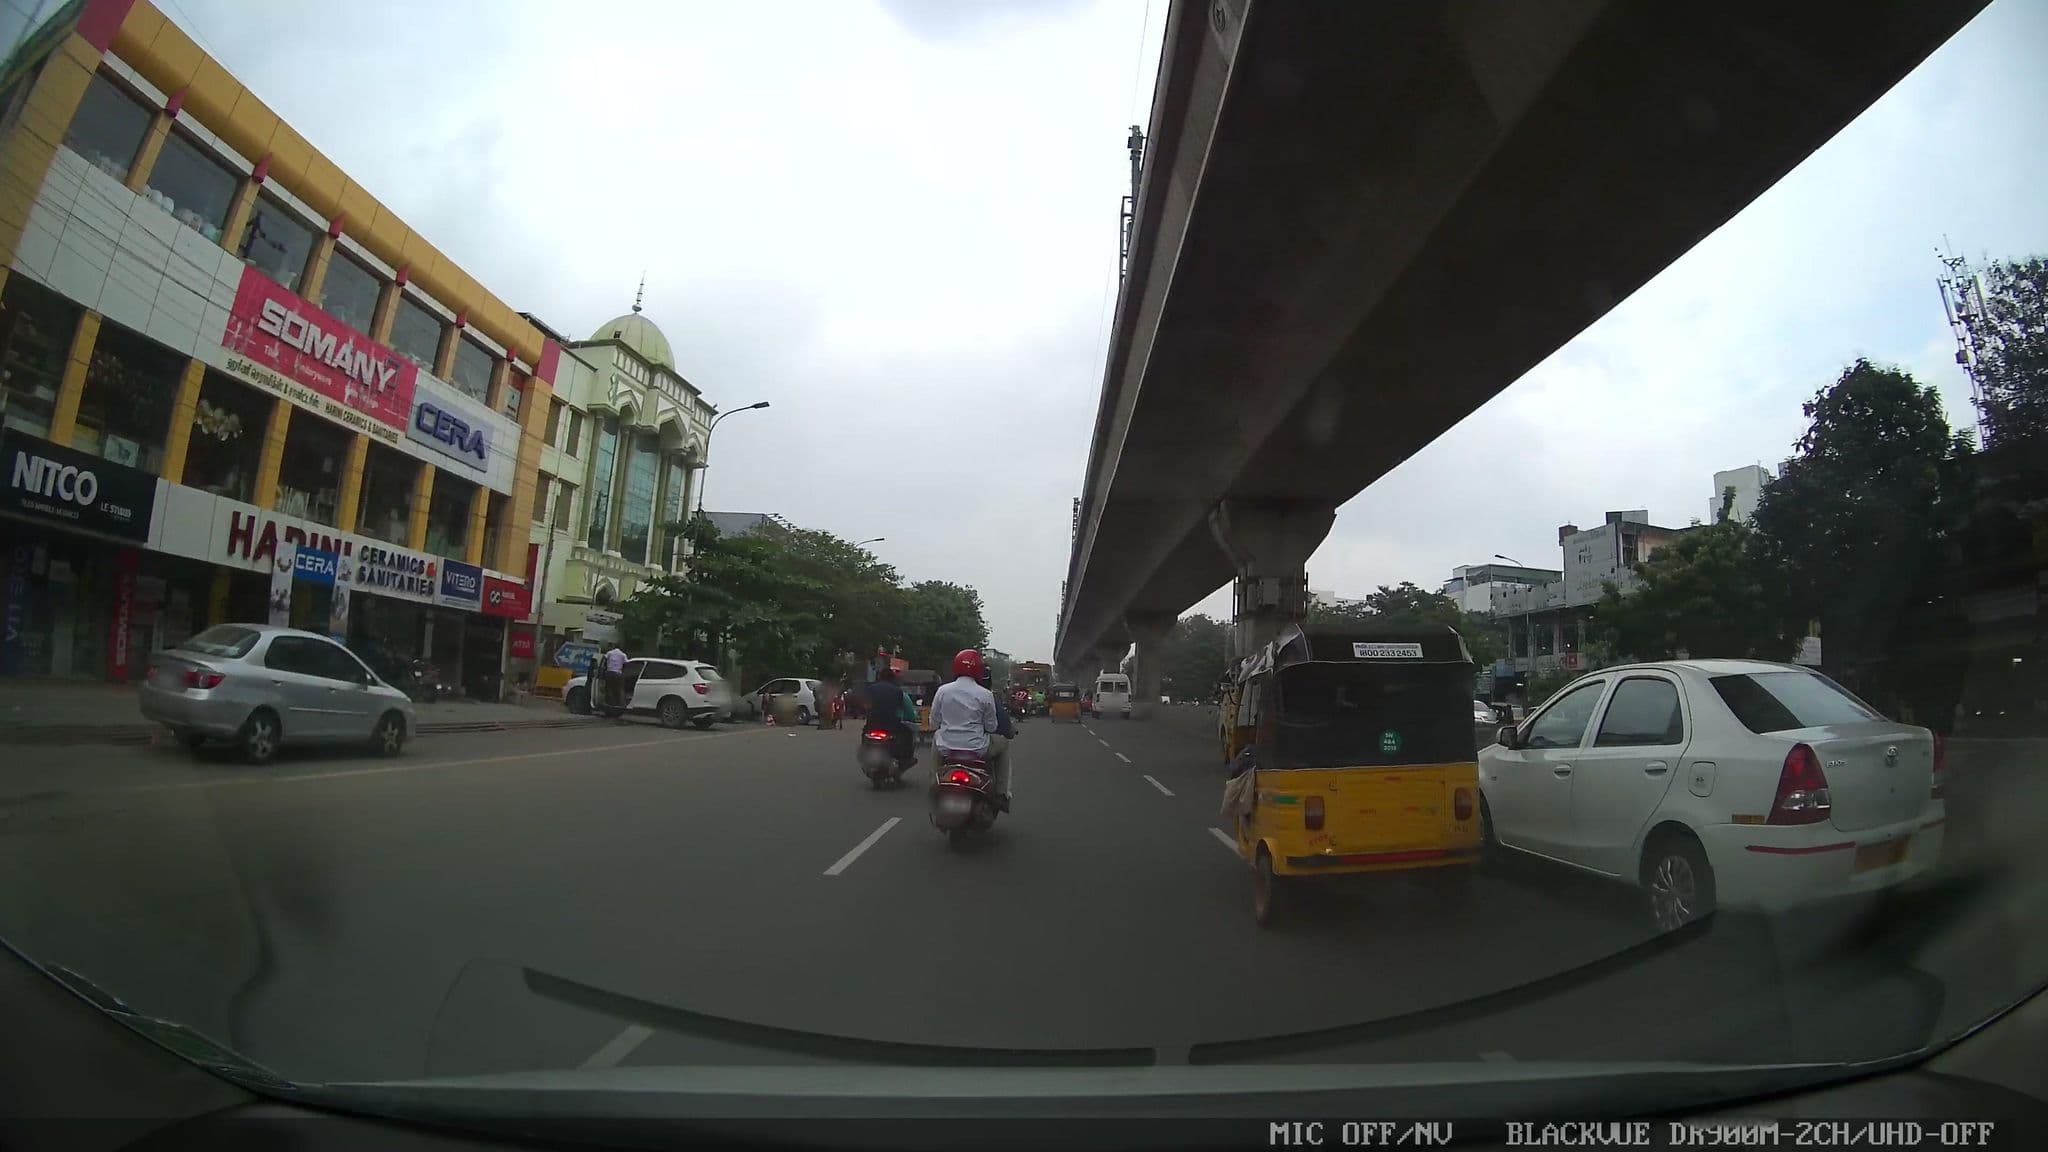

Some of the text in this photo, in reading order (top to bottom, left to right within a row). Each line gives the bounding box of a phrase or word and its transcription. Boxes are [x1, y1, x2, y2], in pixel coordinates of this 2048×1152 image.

[257, 297, 396, 393] SOMANY
[343, 409, 368, 431] CERAMICS
[416, 402, 486, 460] CERA
[11, 450, 98, 506] NITCO
[296, 553, 335, 576] CERA
[360, 545, 425, 576] CERAMICS
[357, 566, 434, 597] SANITARIES
